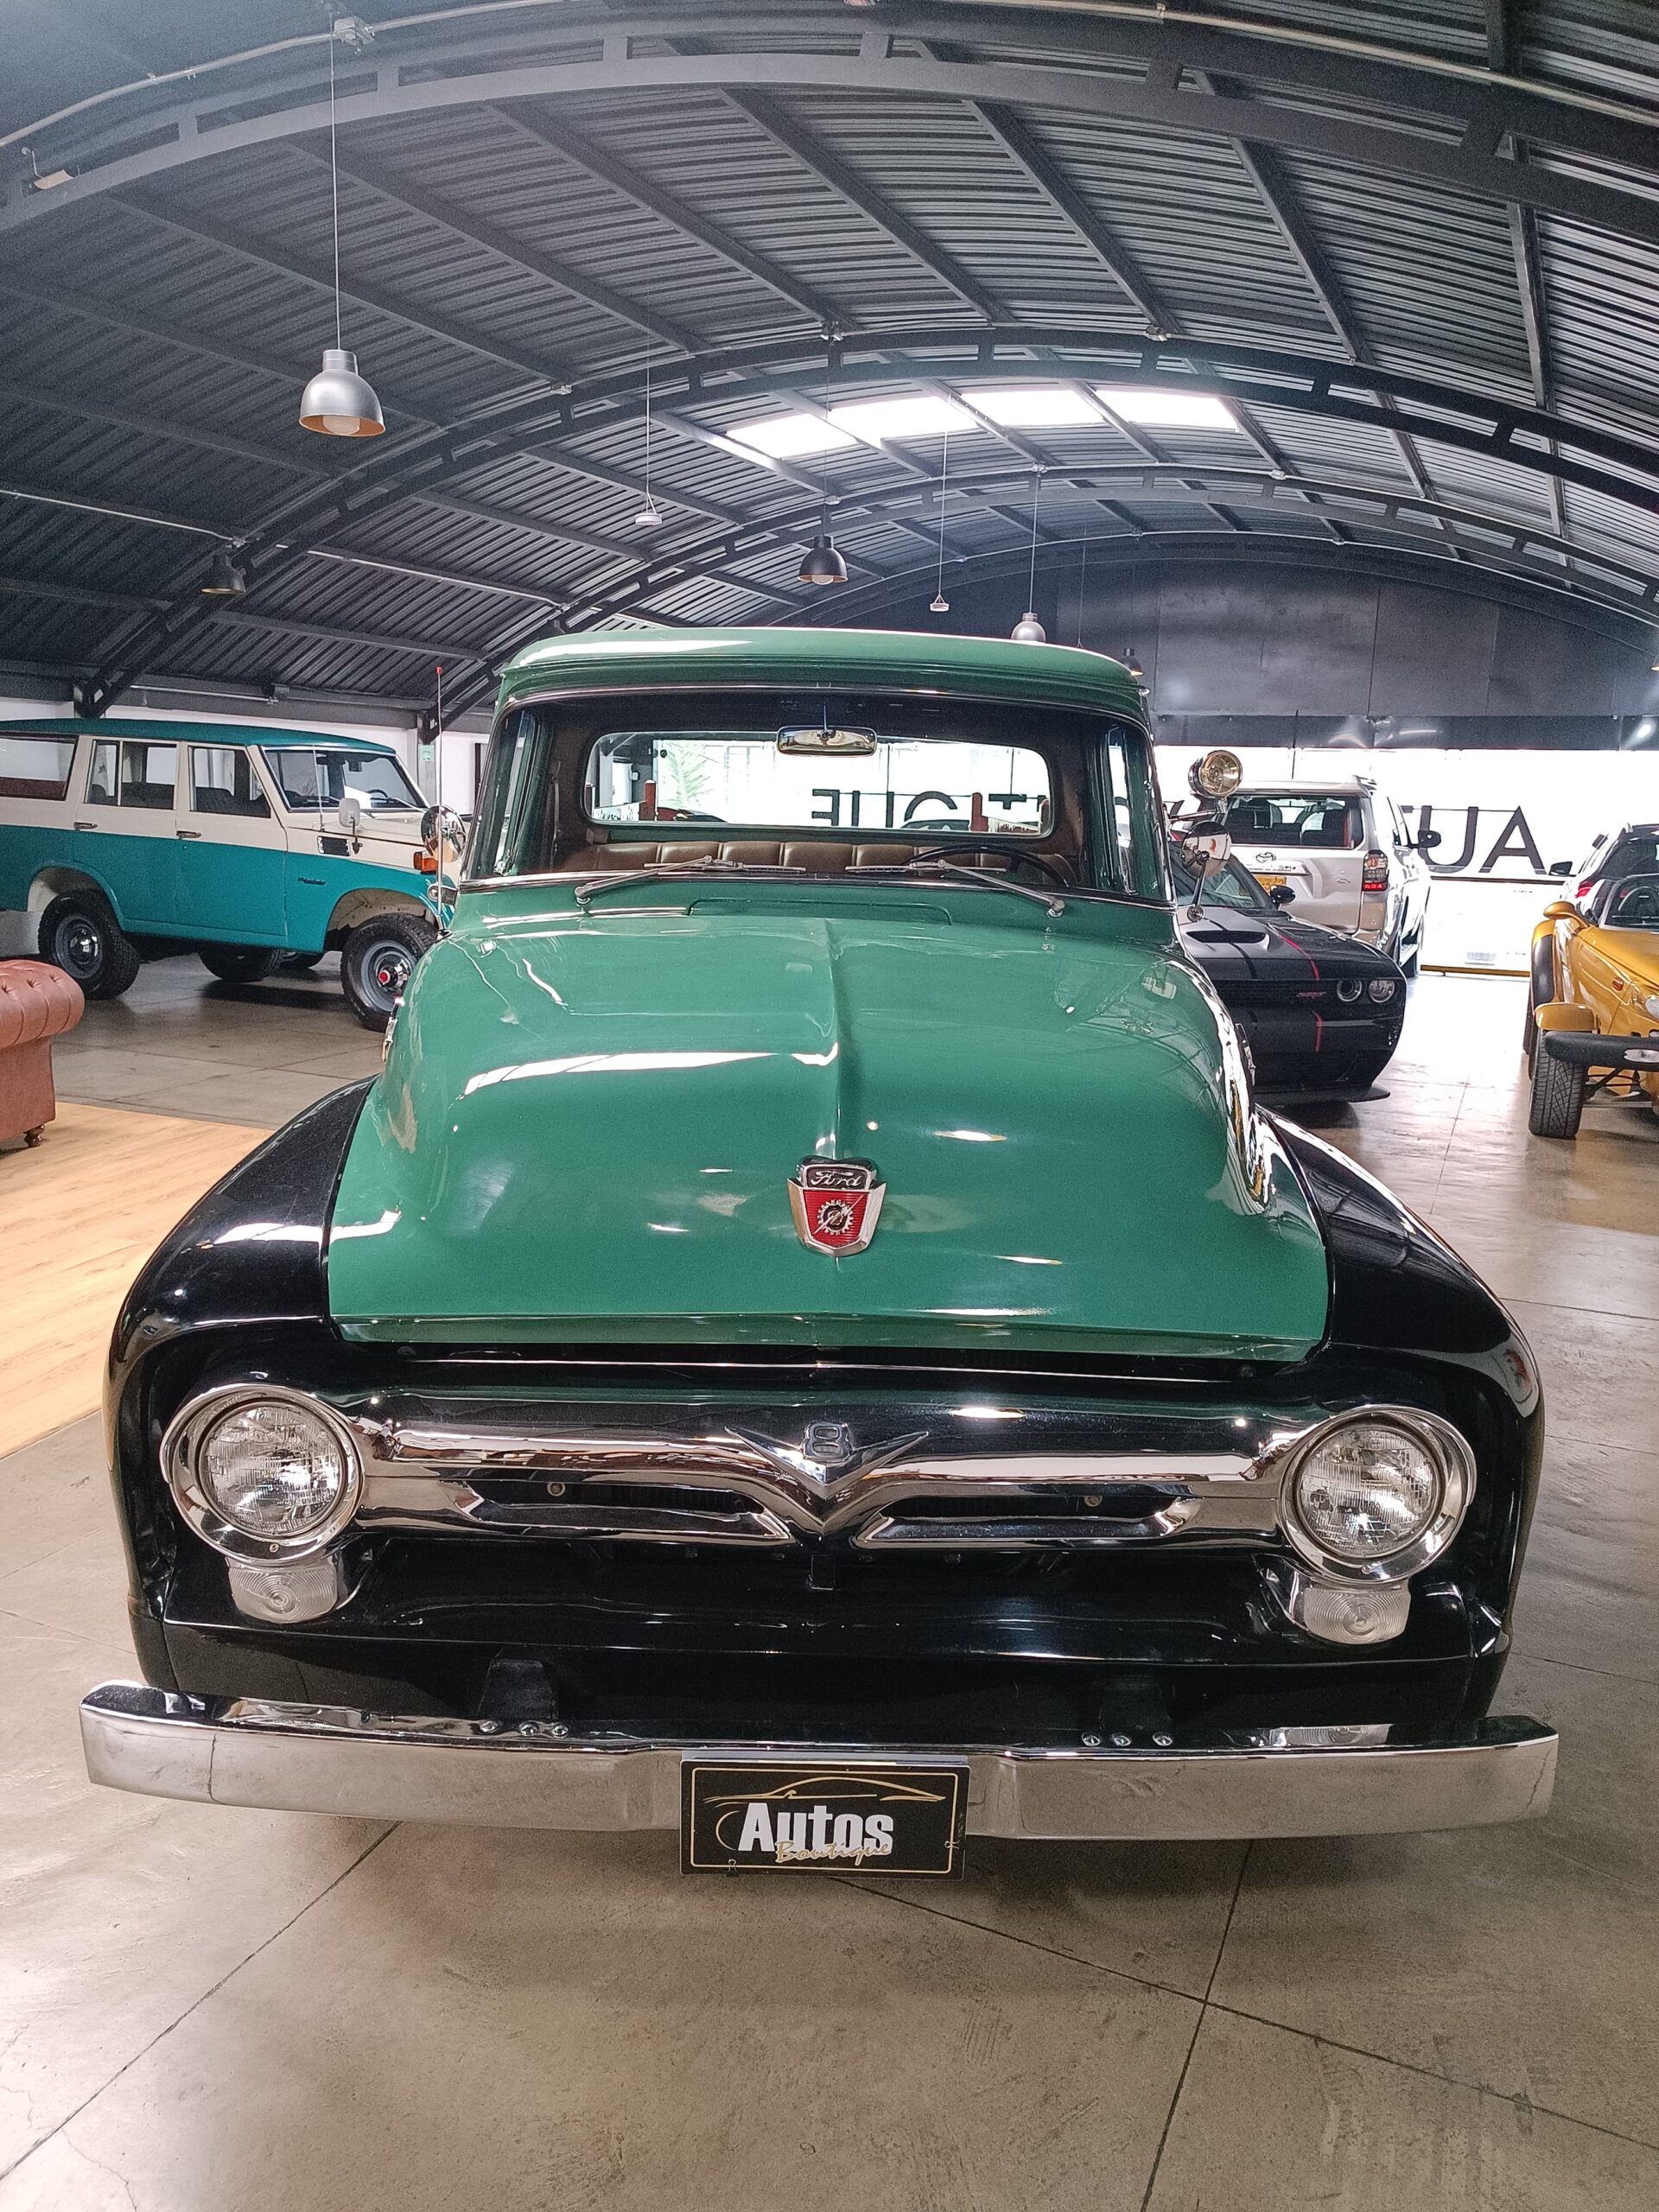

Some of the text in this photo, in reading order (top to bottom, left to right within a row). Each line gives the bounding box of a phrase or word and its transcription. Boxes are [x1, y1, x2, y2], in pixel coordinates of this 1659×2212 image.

[810, 1171, 862, 1187] Ford
[737, 1802, 894, 1856] Autos
[774, 1840, 892, 1866] Boutique
